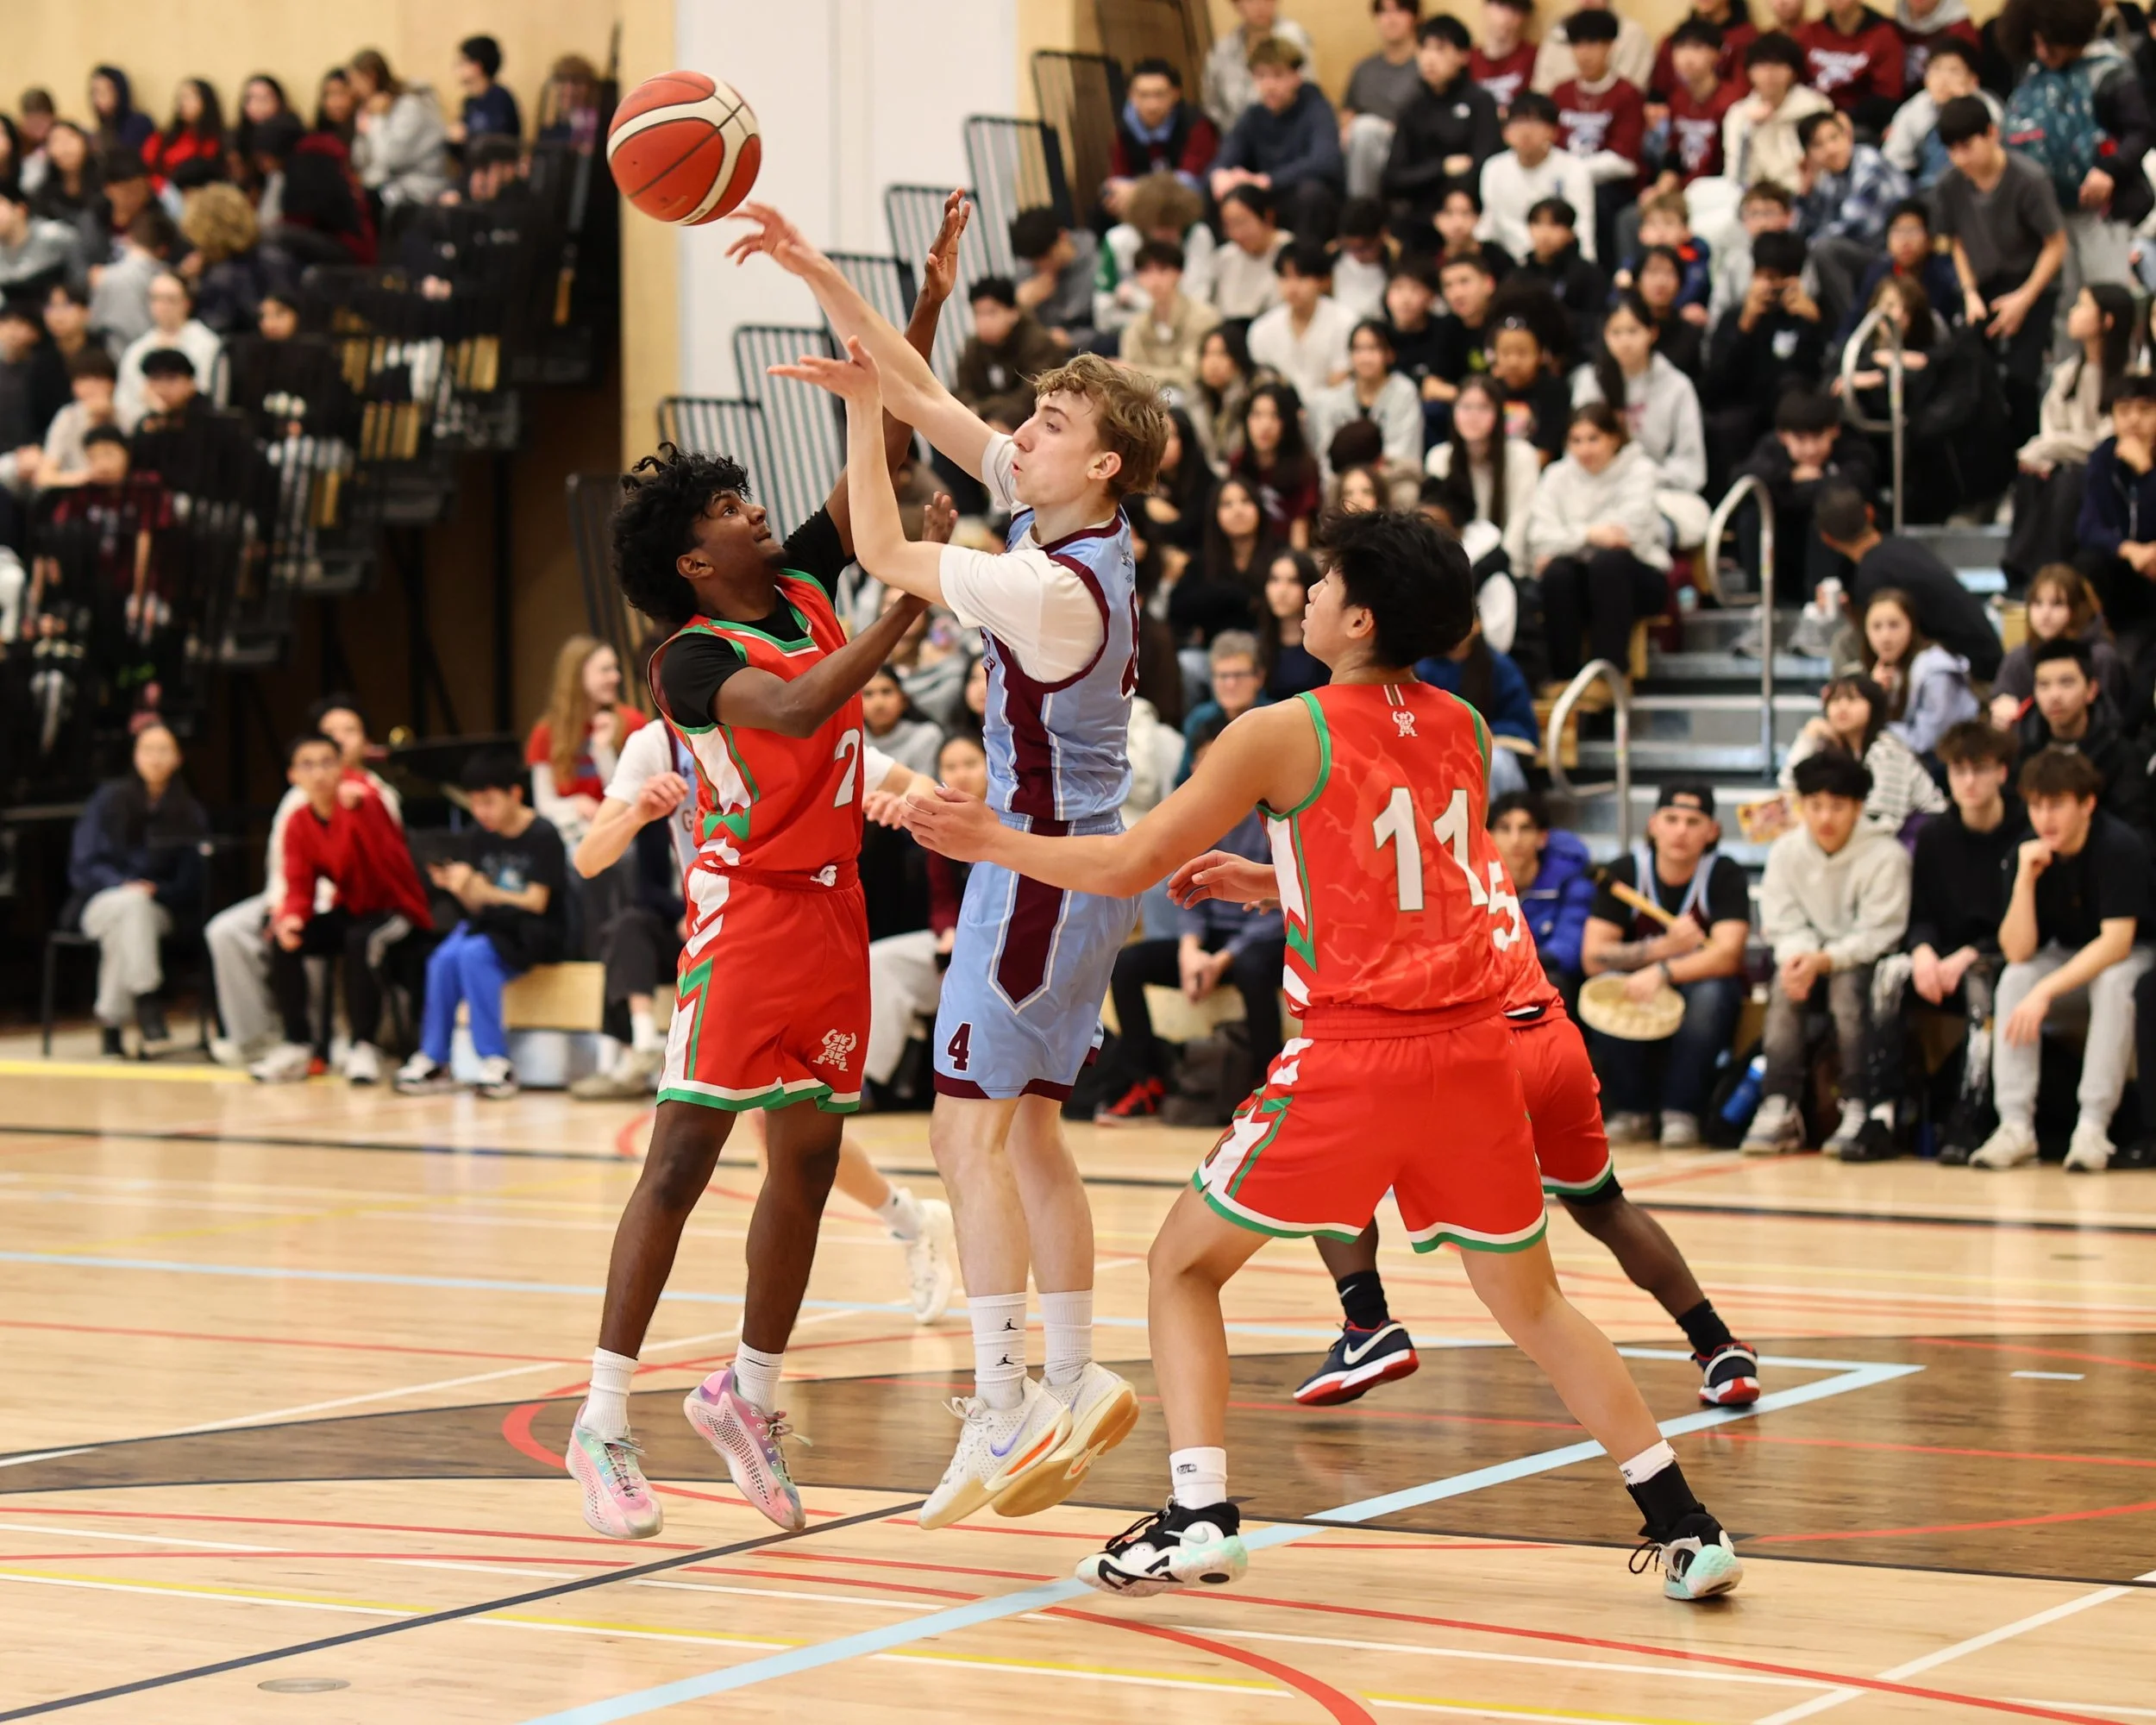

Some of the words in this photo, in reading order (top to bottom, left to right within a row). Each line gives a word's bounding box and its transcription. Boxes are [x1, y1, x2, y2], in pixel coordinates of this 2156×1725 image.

[834, 728, 861, 808] 2
[1372, 787, 1489, 912] 11
[1488, 861, 1521, 952] 5
[947, 1021, 973, 1072] 4
